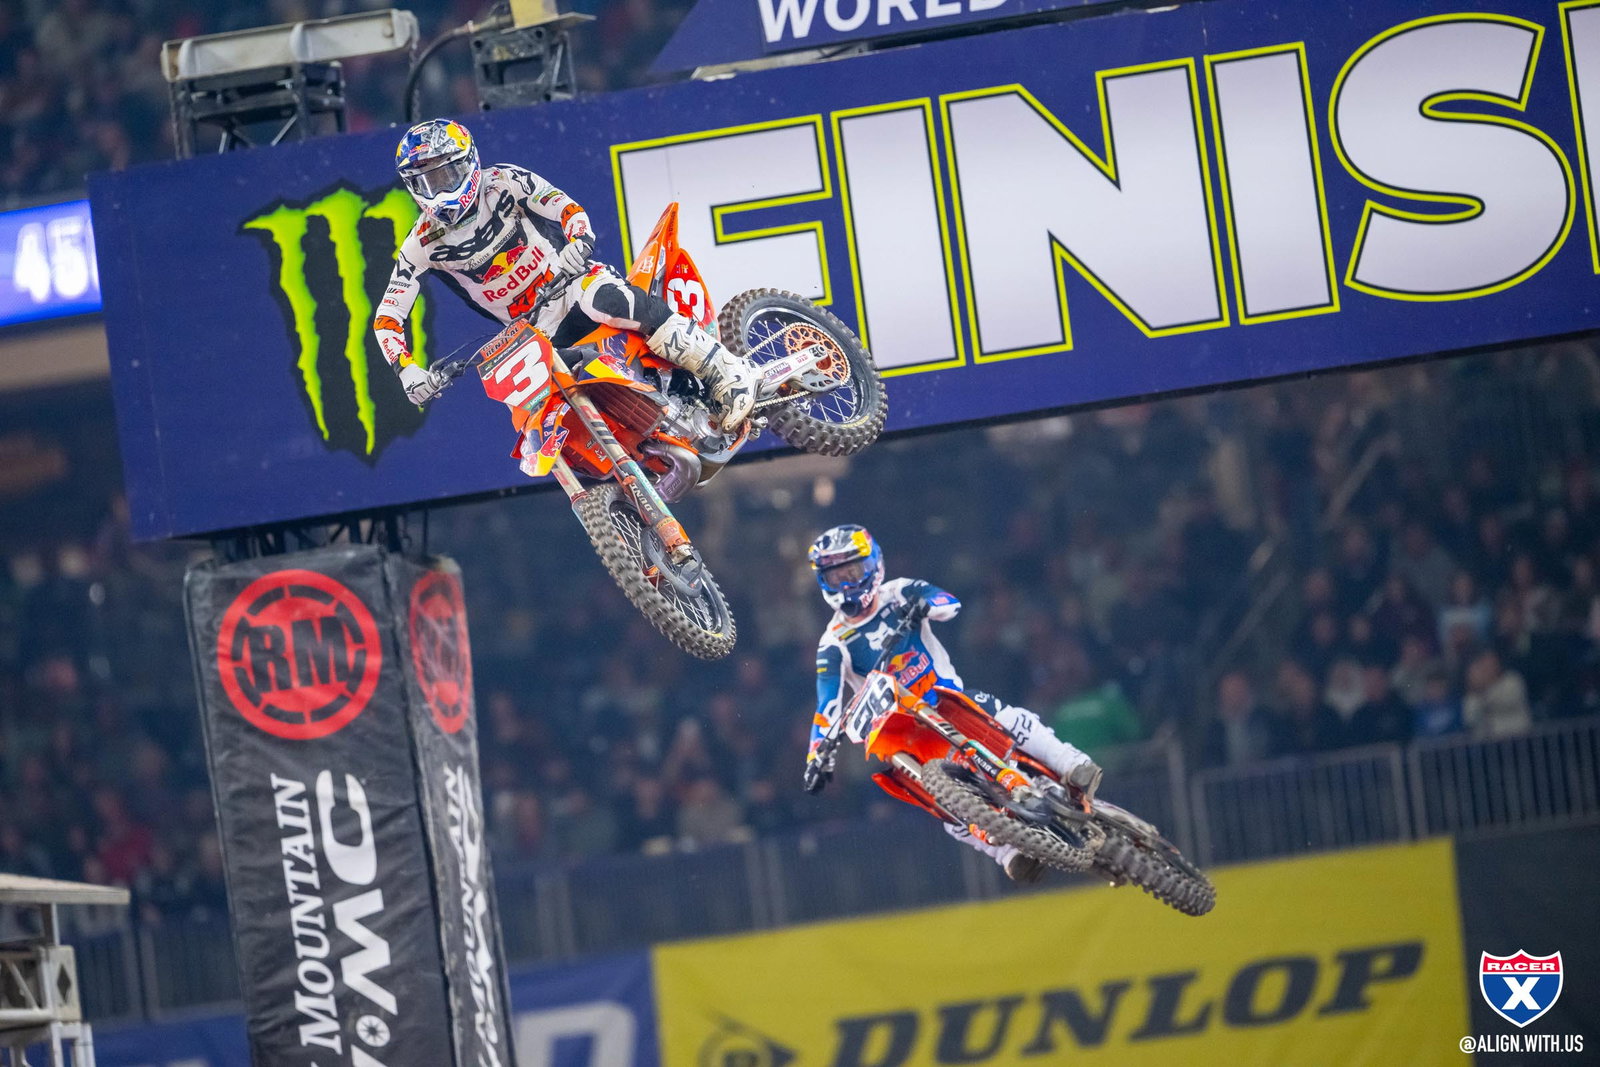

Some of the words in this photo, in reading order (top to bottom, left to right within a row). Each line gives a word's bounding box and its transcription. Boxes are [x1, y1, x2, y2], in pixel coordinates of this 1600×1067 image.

[758, 0, 1006, 43] WOR
[609, 0, 1600, 379] FINIS
[482, 274, 520, 302] Red
[515, 245, 545, 282] Bull
[494, 340, 550, 407] 3
[248, 615, 348, 697] RM
[907, 652, 930, 678] Bull
[270, 772, 343, 1056] MOUNTAIN
[828, 940, 1426, 1067] DUNLOP
